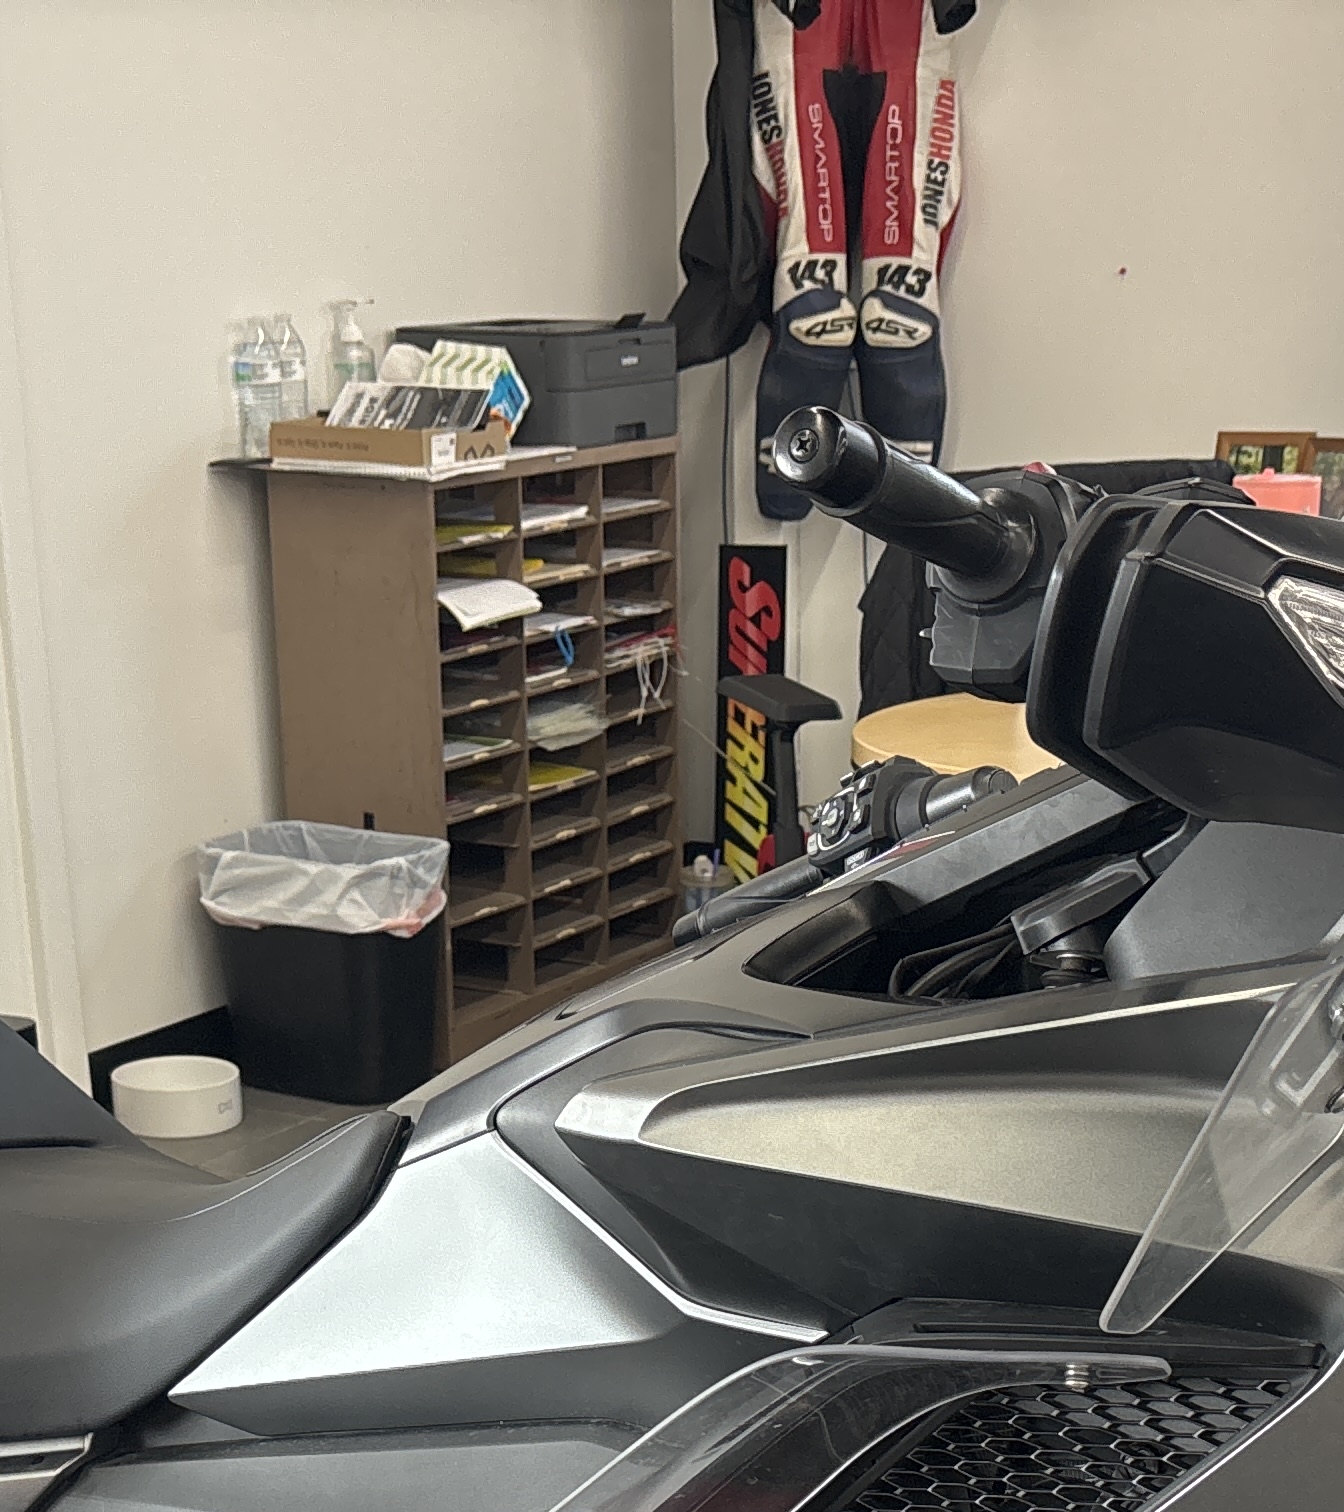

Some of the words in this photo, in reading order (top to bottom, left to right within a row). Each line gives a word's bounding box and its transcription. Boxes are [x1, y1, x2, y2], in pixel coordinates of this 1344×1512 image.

[808, 103, 833, 242] SMARTOP
[884, 104, 903, 245] SMARTOP
[877, 264, 932, 298] 143
